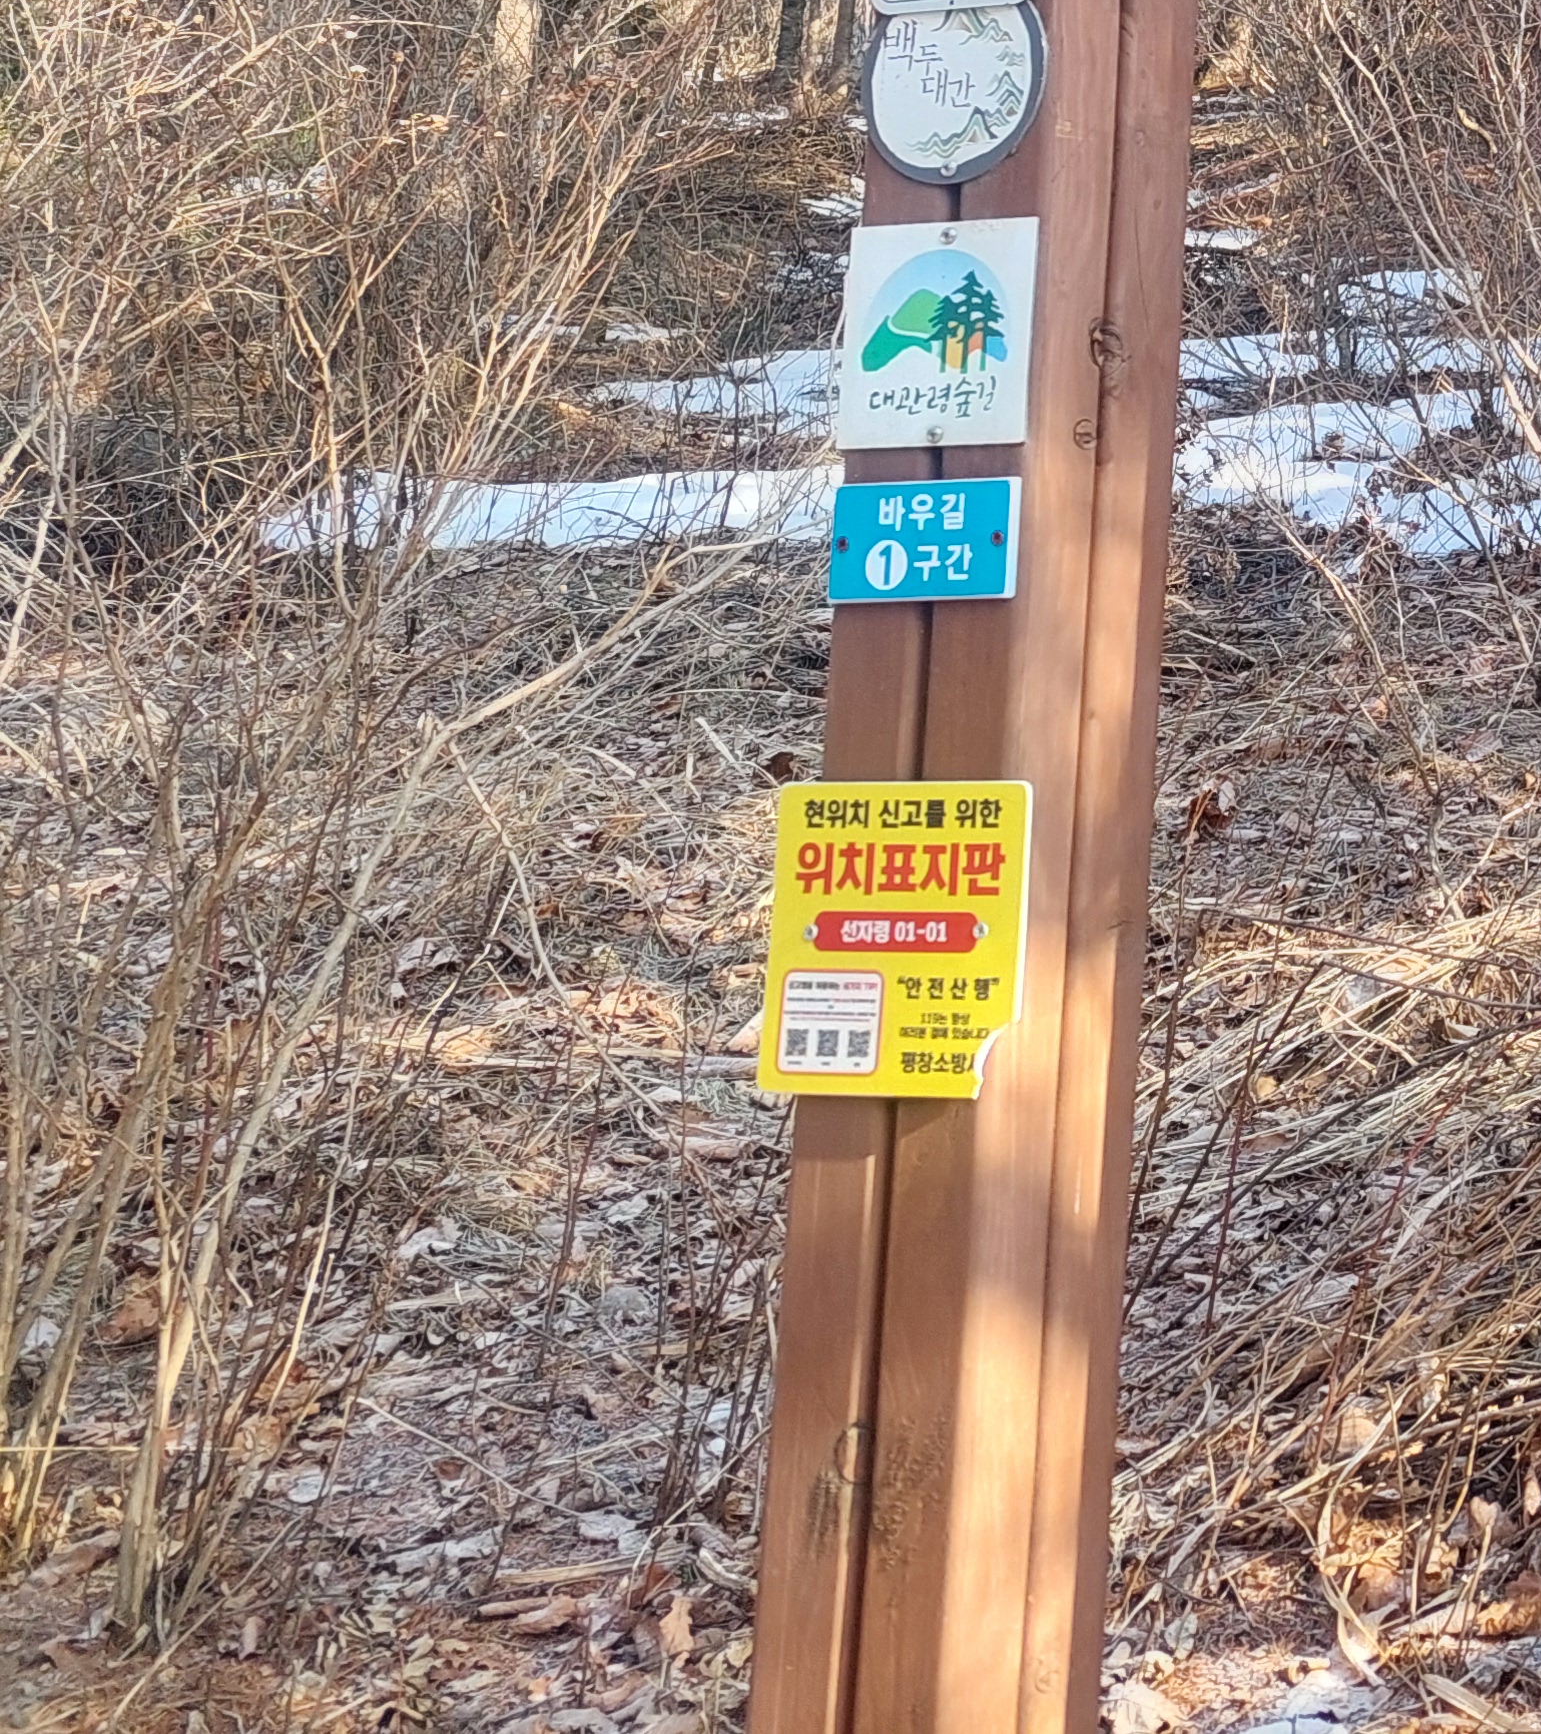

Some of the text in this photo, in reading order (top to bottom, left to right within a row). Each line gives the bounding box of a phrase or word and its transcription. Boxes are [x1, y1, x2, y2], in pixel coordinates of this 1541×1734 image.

[884, 19, 943, 76] 백두
[921, 68, 976, 108] 대간
[869, 375, 997, 419] 대관령숲길
[878, 493, 966, 532] 바우길
[913, 543, 973, 581] 구간
[804, 798, 1003, 829] 현위치 신고를 위한
[796, 841, 1006, 896] 위치표지판
[840, 919, 947, 944] 선자령 01-01
[950, 977, 968, 1000] 산
